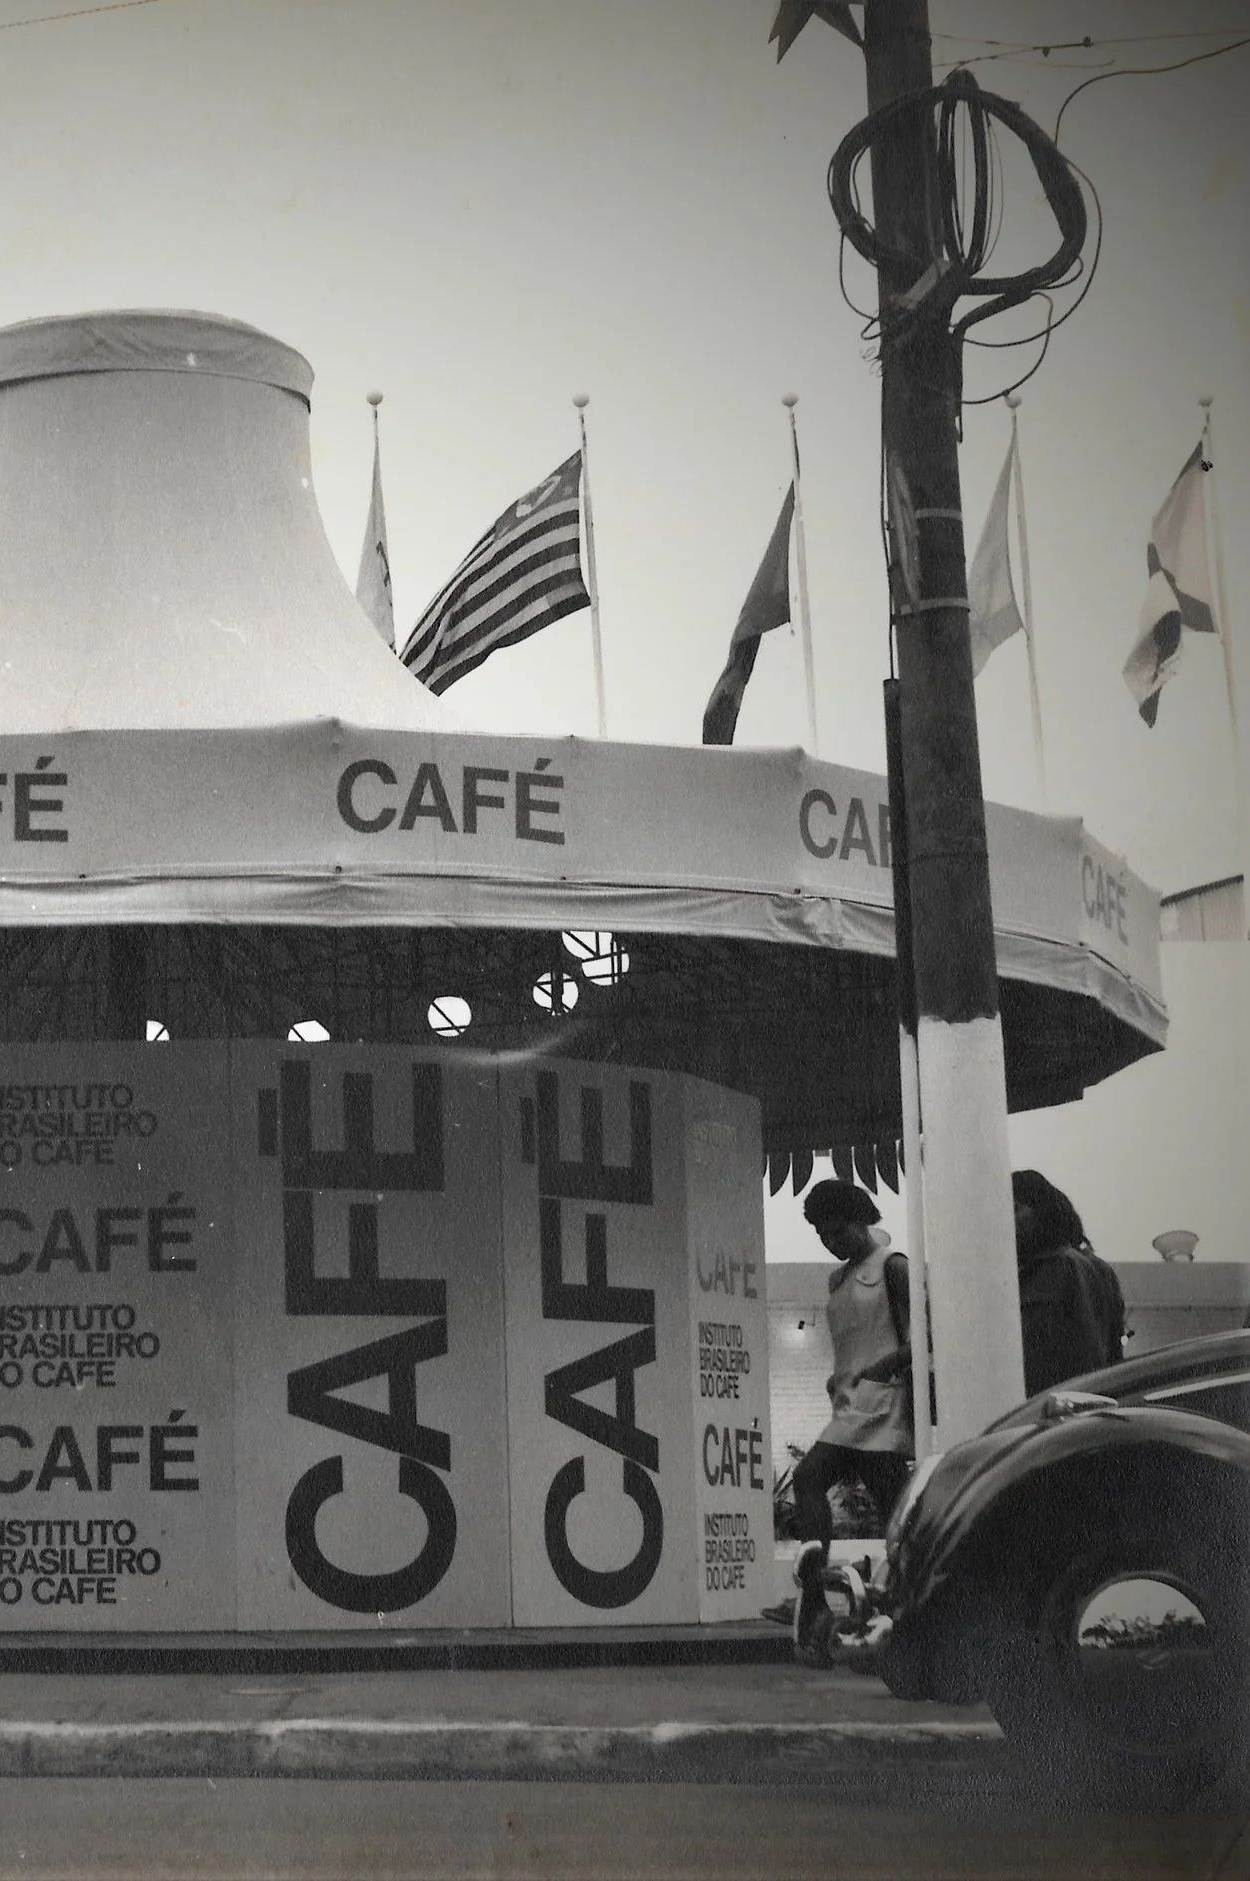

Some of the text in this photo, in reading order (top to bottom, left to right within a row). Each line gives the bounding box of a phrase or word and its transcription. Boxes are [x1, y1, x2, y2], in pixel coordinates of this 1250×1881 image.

[336, 757, 566, 847] CAFÉ
[799, 789, 891, 868] CAF
[257, 1059, 457, 1614] CAFÉ
[520, 1070, 663, 1610] CAFÉ
[703, 1417, 764, 1490] CAFÉ
[704, 1513, 749, 1537] INSTITUTO
